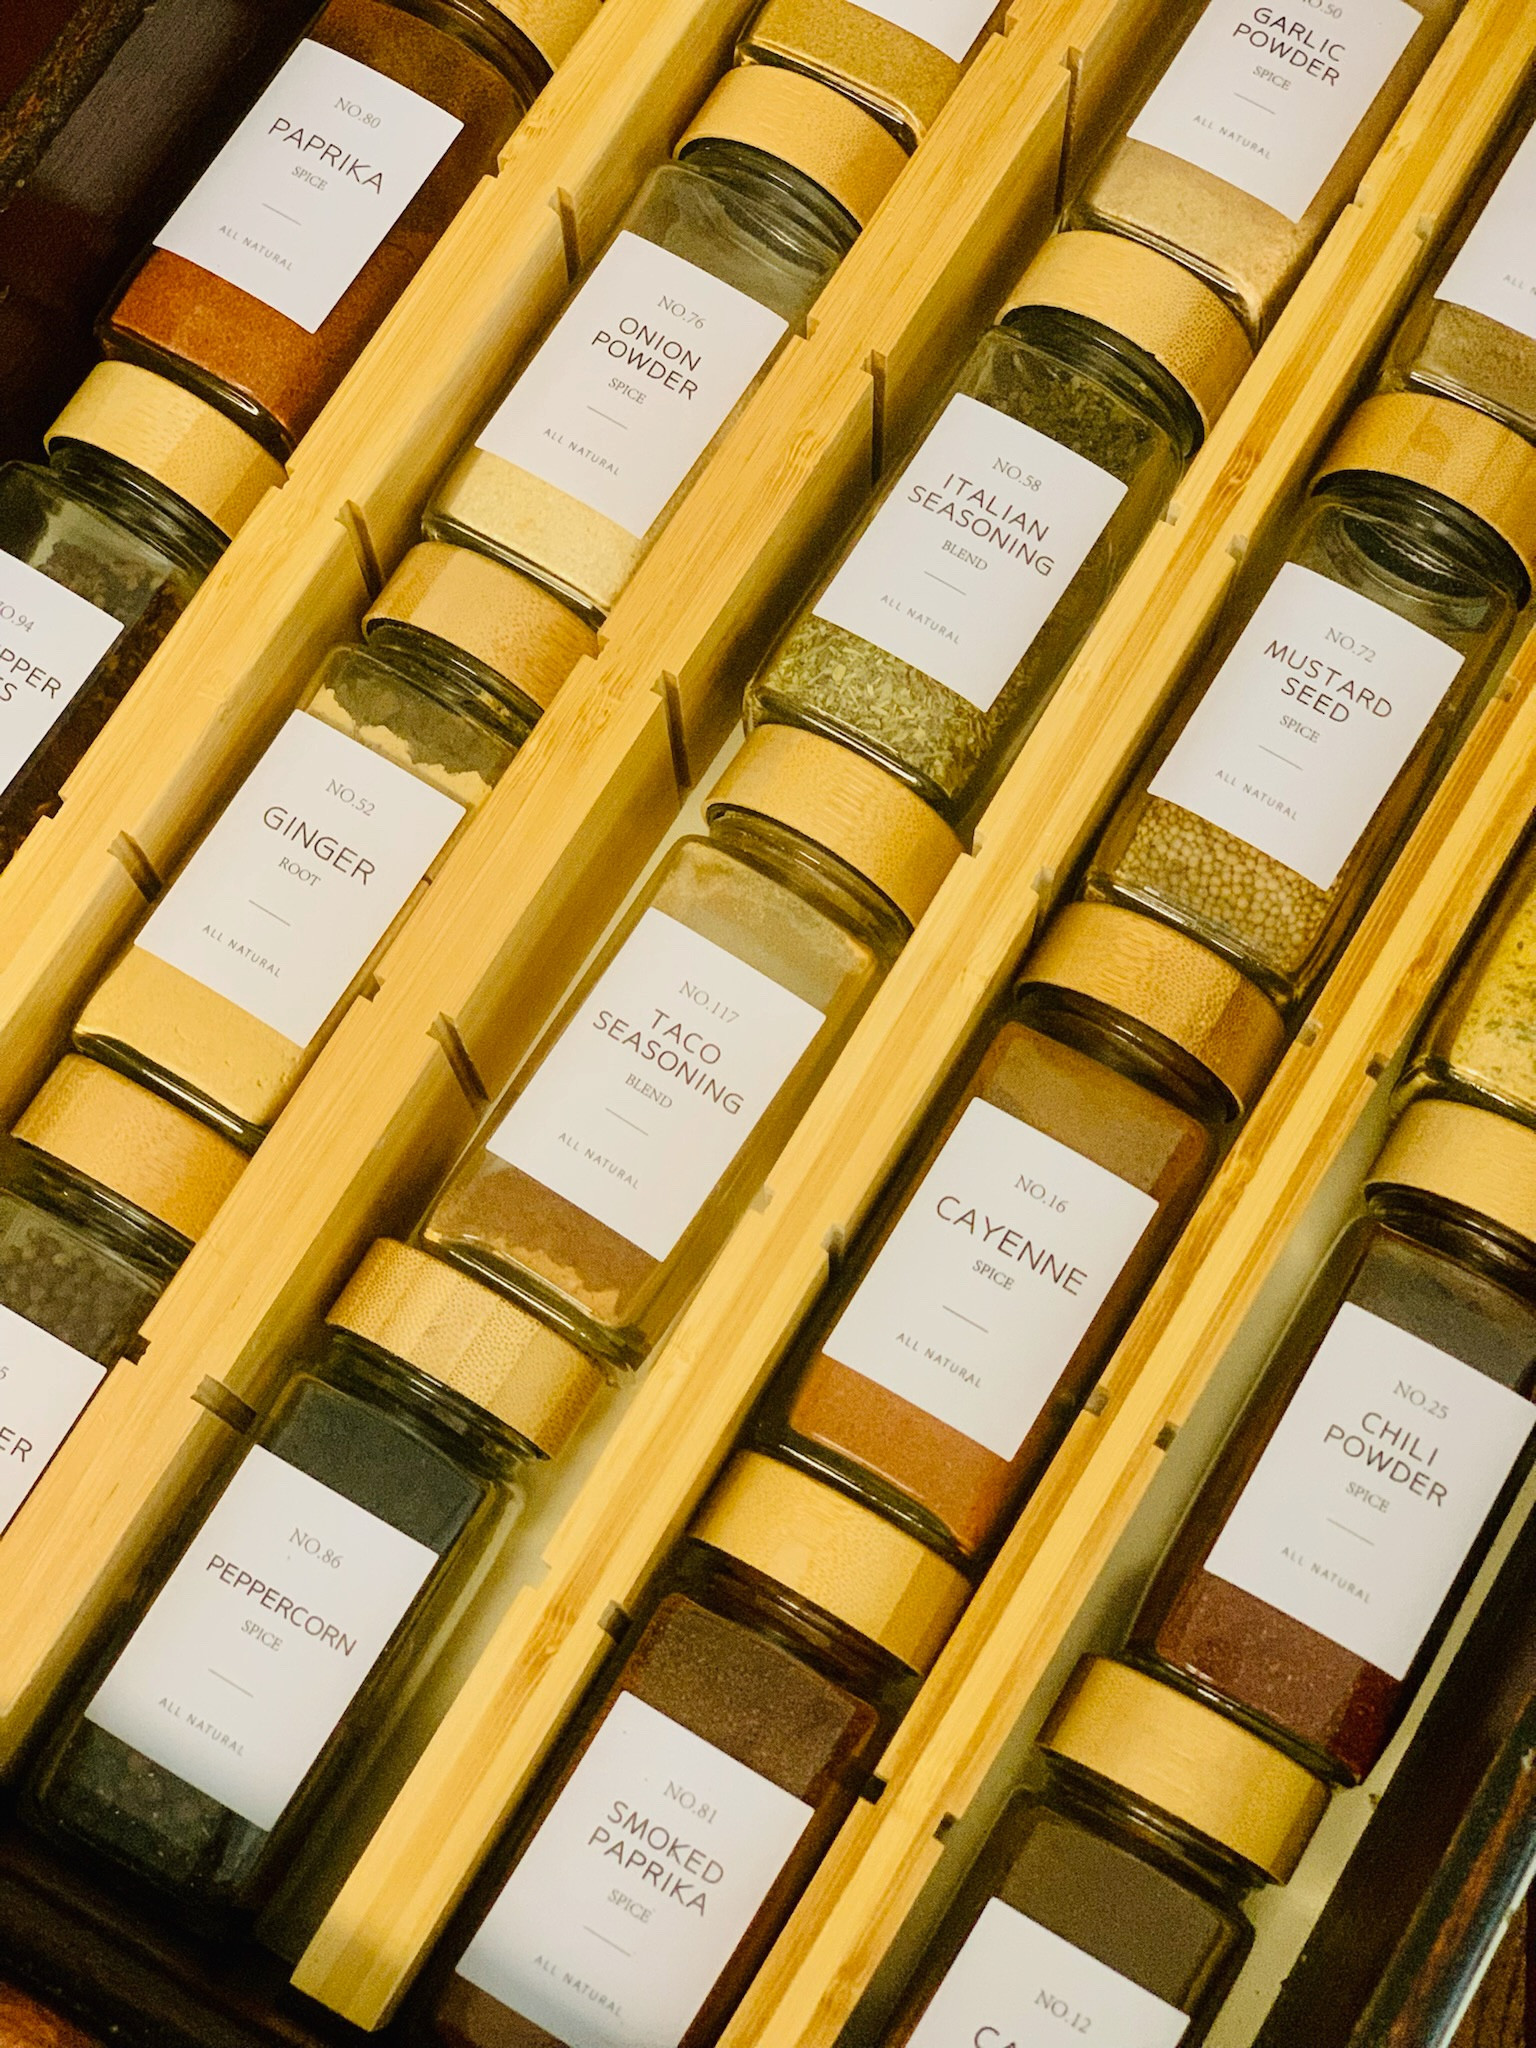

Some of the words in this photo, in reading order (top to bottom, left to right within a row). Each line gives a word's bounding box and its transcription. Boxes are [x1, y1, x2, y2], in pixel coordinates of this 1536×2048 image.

[1302, 0, 1343, 19] O.50
[1232, 22, 1340, 87] POWDER
[1253, 7, 1346, 62] GARLIC
[1252, 65, 1292, 91] SPICE
[333, 96, 382, 129] NO.80
[268, 117, 383, 195] PAPRIKA
[1193, 114, 1213, 130] ALL
[1218, 126, 1270, 160] NATURAL
[291, 166, 328, 191] SPICE
[218, 225, 238, 241] ALL
[242, 236, 293, 271] NATURAL
[1502, 274, 1524, 290] ALL
[657, 295, 705, 329] NO.76
[591, 330, 698, 401] POWDER
[619, 317, 702, 372] ONION
[607, 377, 647, 405] SPICE
[544, 428, 564, 445] ALL
[568, 441, 619, 476] NATURAL
[991, 456, 1042, 492] NO.58
[943, 473, 1050, 542] ITALIAN
[907, 485, 1055, 577] SEASONING
[941, 539, 988, 570] BLEND
[0, 600, 35, 633] O.94
[880, 594, 902, 612] ALL
[906, 607, 960, 645] NATURAL
[1324, 626, 1376, 663] NO.72
[0, 646, 62, 700] PPER
[0, 676, 18, 702] S
[1263, 639, 1392, 718] MUSTARD
[1280, 677, 1350, 723] SEED
[1279, 714, 1321, 742] SPICE
[325, 778, 376, 817] NO.52
[1215, 769, 1237, 787] ALL
[1242, 783, 1297, 821] NATURAL
[263, 806, 376, 886] GINGER
[278, 856, 322, 887] ROOT
[202, 924, 223, 942] ALL
[227, 938, 281, 978] NATURAL
[678, 980, 740, 1023] NO.117
[651, 1008, 721, 1065] TACO
[592, 1010, 744, 1115] SEASONING
[624, 1073, 673, 1108] BLEND
[558, 1132, 580, 1152] ALL
[584, 1147, 639, 1190] NATURAL
[1014, 1174, 1066, 1213] NO.16
[936, 1195, 1088, 1296] CAYENNE
[972, 1259, 1015, 1291] SPICE
[895, 1332, 919, 1352] ALL
[923, 1347, 981, 1388] NATURAL
[1392, 1379, 1449, 1420] NO.25
[1361, 1412, 1439, 1467] CHILI
[1323, 1423, 1448, 1507] POWDER
[1345, 1481, 1390, 1514] SPICE
[288, 1527, 342, 1569] NO.86
[1281, 1546, 1304, 1566] ALL
[1310, 1562, 1370, 1604] NATURAL
[205, 1554, 357, 1657] PEPPERCORN
[240, 1619, 283, 1652] SPICE
[158, 1697, 181, 1717] ALL
[186, 1713, 244, 1757] NATURAL
[663, 1780, 718, 1825] NO.81
[607, 1800, 724, 1884] SMOKED
[587, 1826, 706, 1917] PAPRIKA
[607, 1888, 652, 1924] SPICE
[534, 1955, 557, 1976] ALL
[563, 1972, 621, 2017] NATURAL
[1034, 1989, 1092, 2034] NO.12
